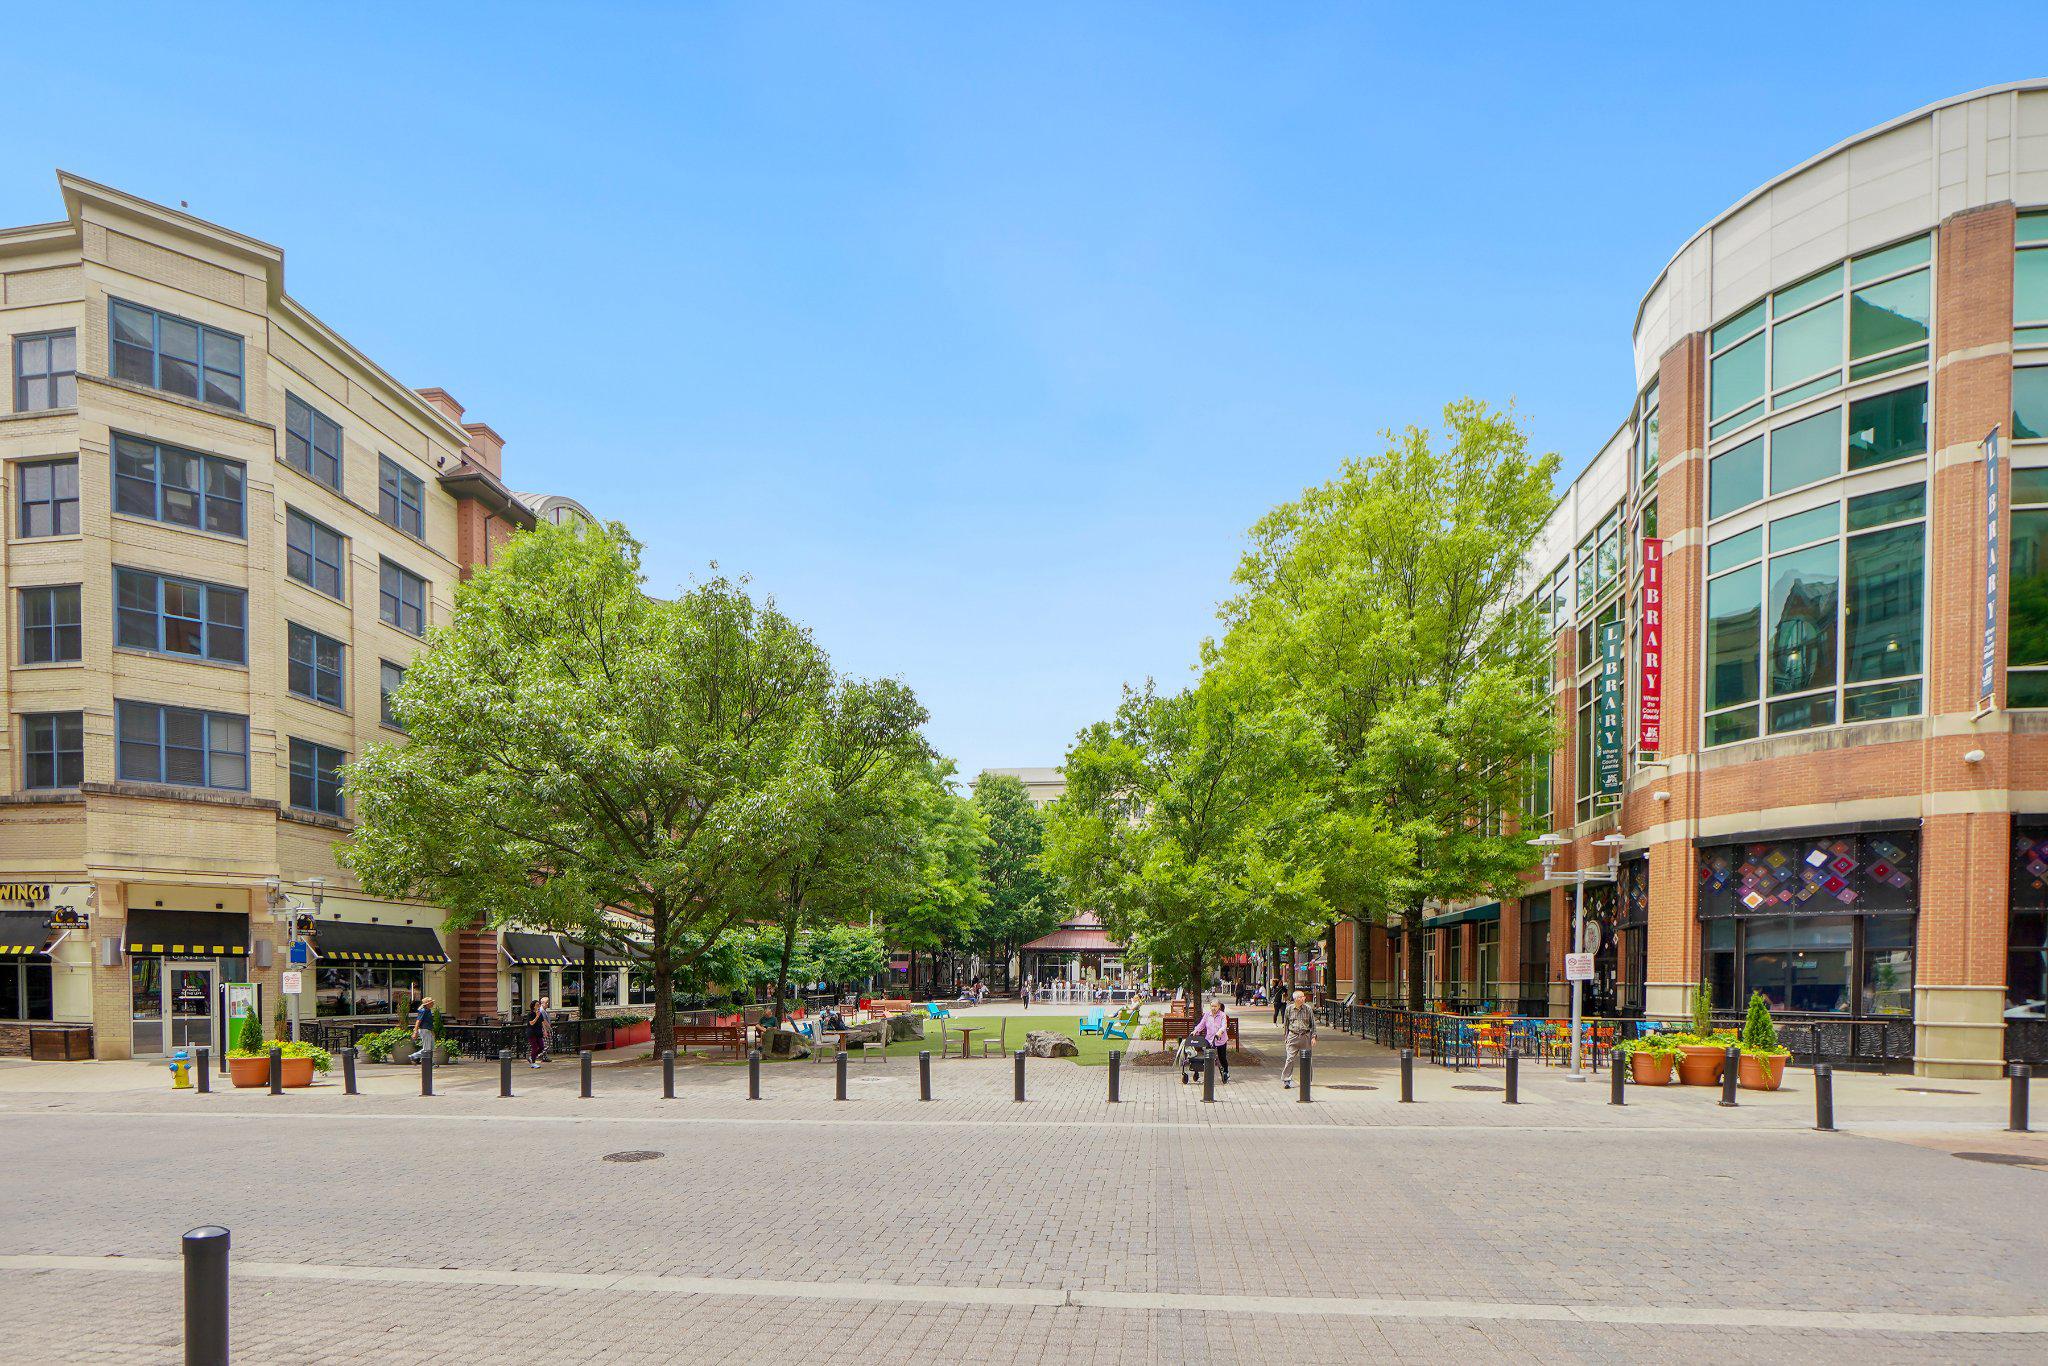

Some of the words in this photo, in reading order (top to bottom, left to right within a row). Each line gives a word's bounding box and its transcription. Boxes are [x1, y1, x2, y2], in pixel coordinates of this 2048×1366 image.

[1988, 442, 1997, 619] LIBRARY
[1646, 546, 1660, 689] LIBRARY
[1605, 628, 1618, 744] LIBRARY
[0, 883, 45, 900] WINGS
